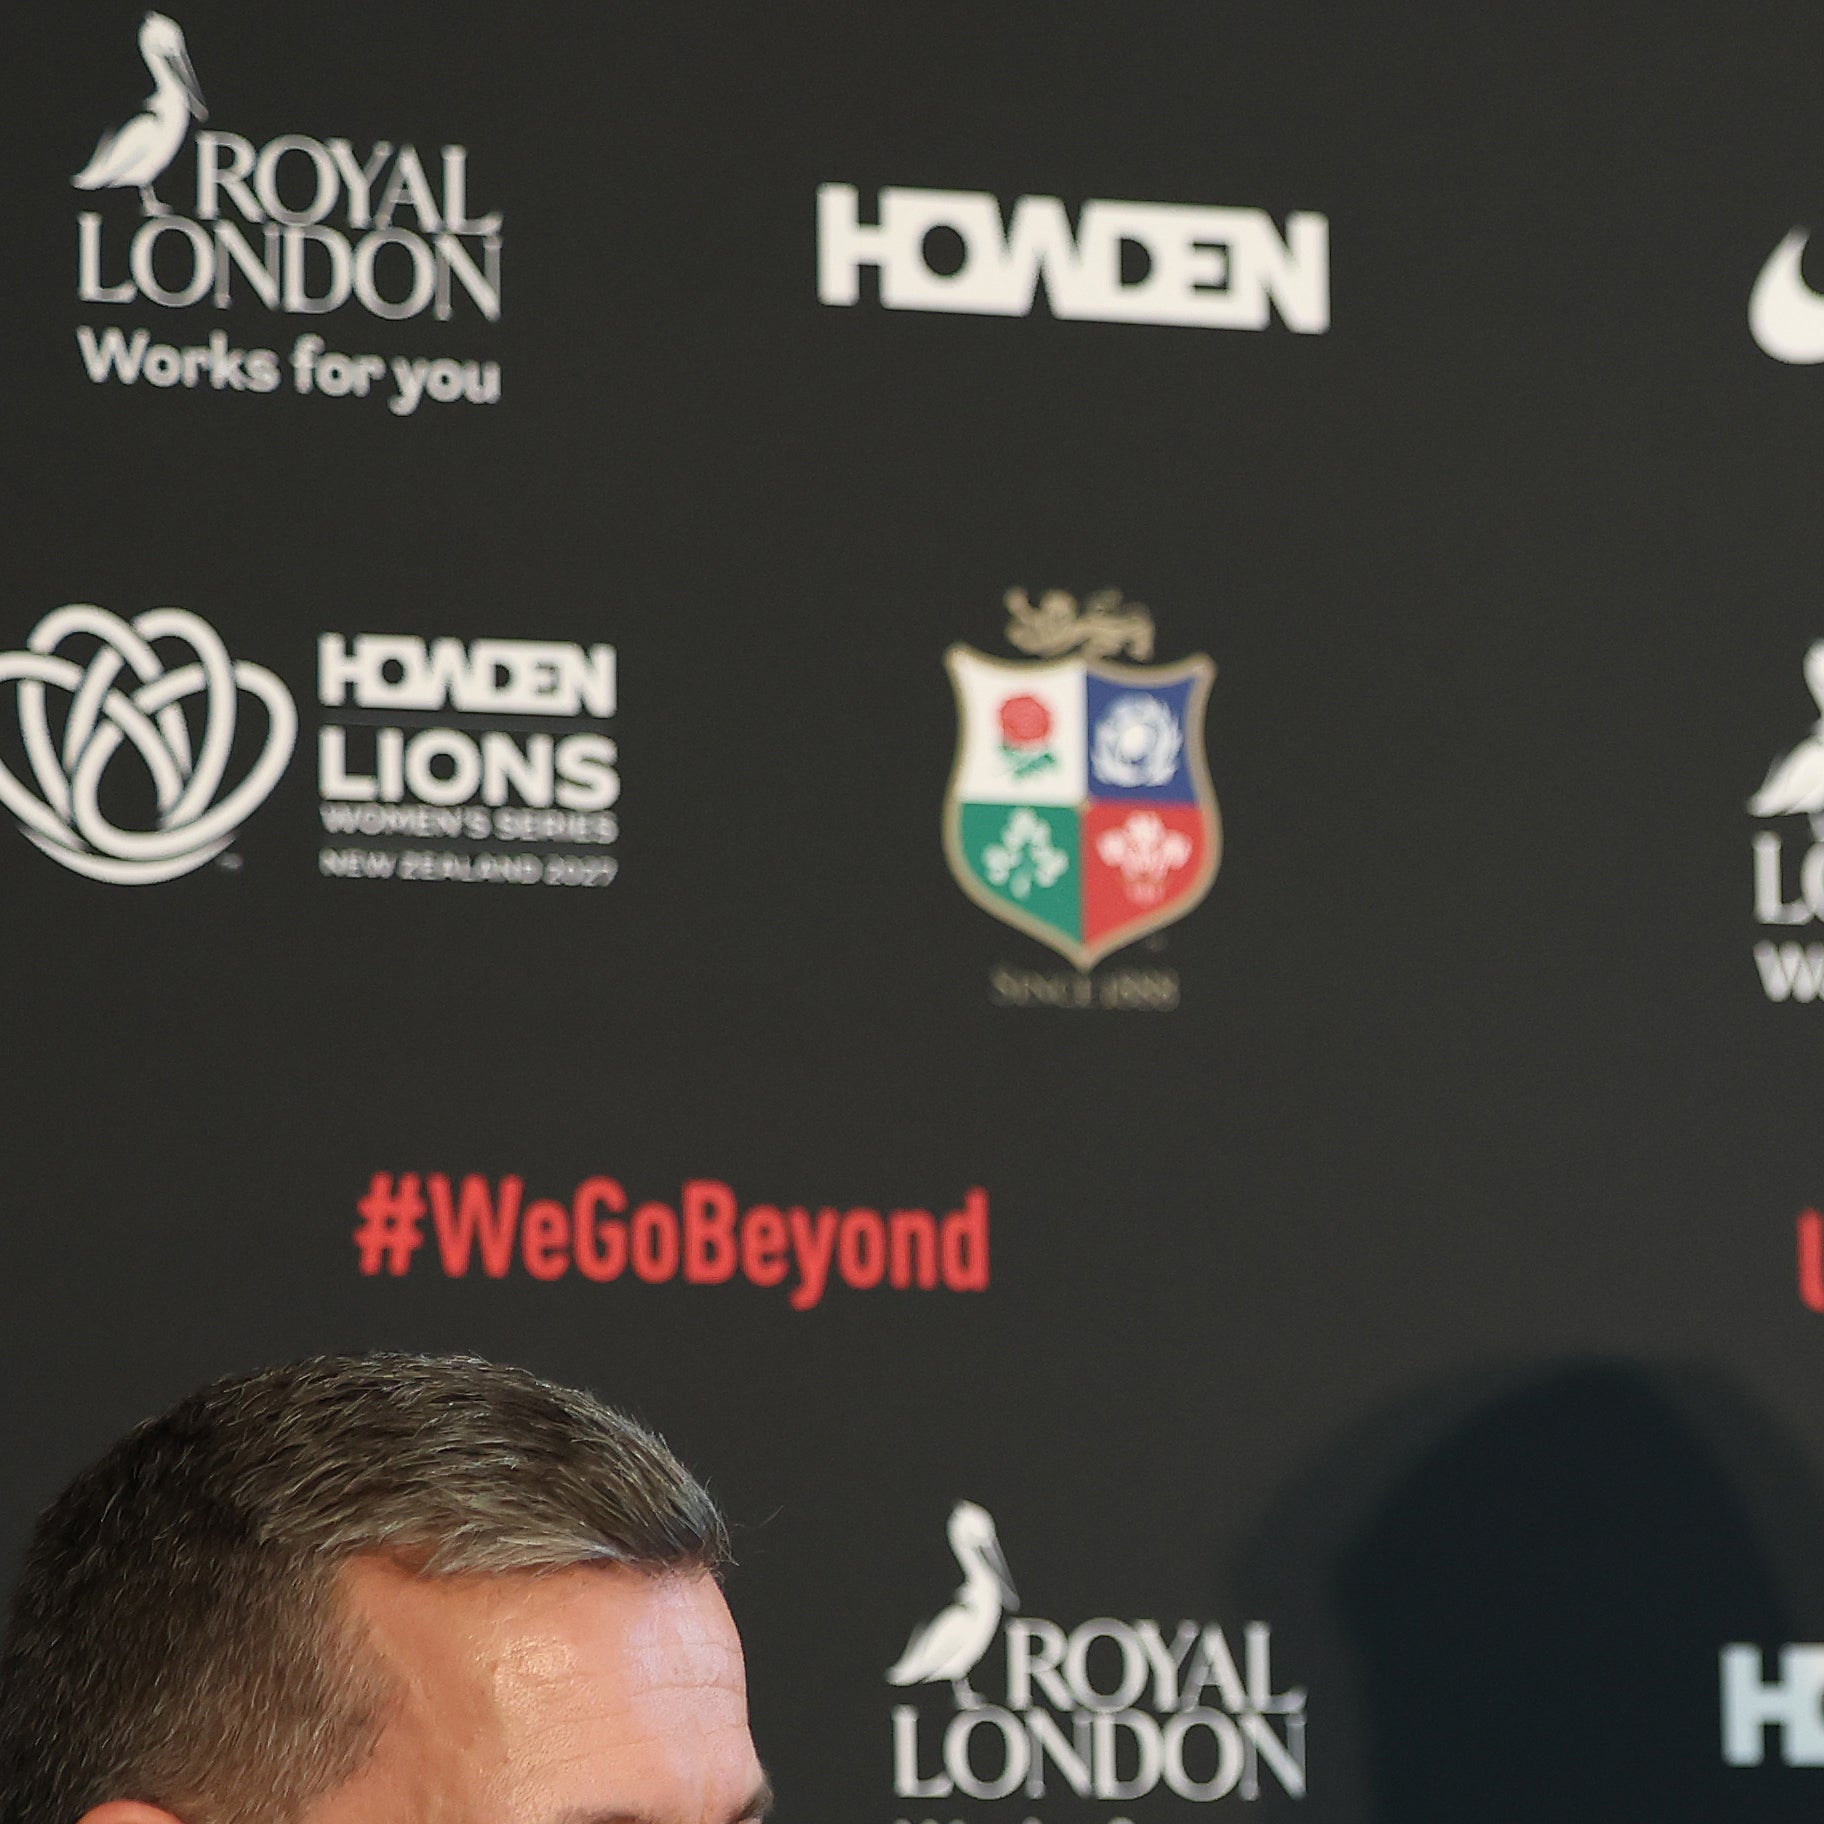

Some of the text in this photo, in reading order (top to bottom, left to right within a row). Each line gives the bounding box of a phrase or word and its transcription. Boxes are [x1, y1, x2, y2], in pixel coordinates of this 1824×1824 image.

[196, 130, 503, 236] ROYAL
[77, 211, 503, 321] LONDON
[815, 181, 1330, 335] HOWDEN
[76, 325, 501, 416] Works for you
[317, 631, 617, 718] HOWDEN
[318, 724, 621, 811] LIONS
[354, 1170, 991, 1311] #WeGoBeyond
[1005, 1617, 1306, 1713] ROYAL
[892, 1704, 1306, 1802] LONDON
